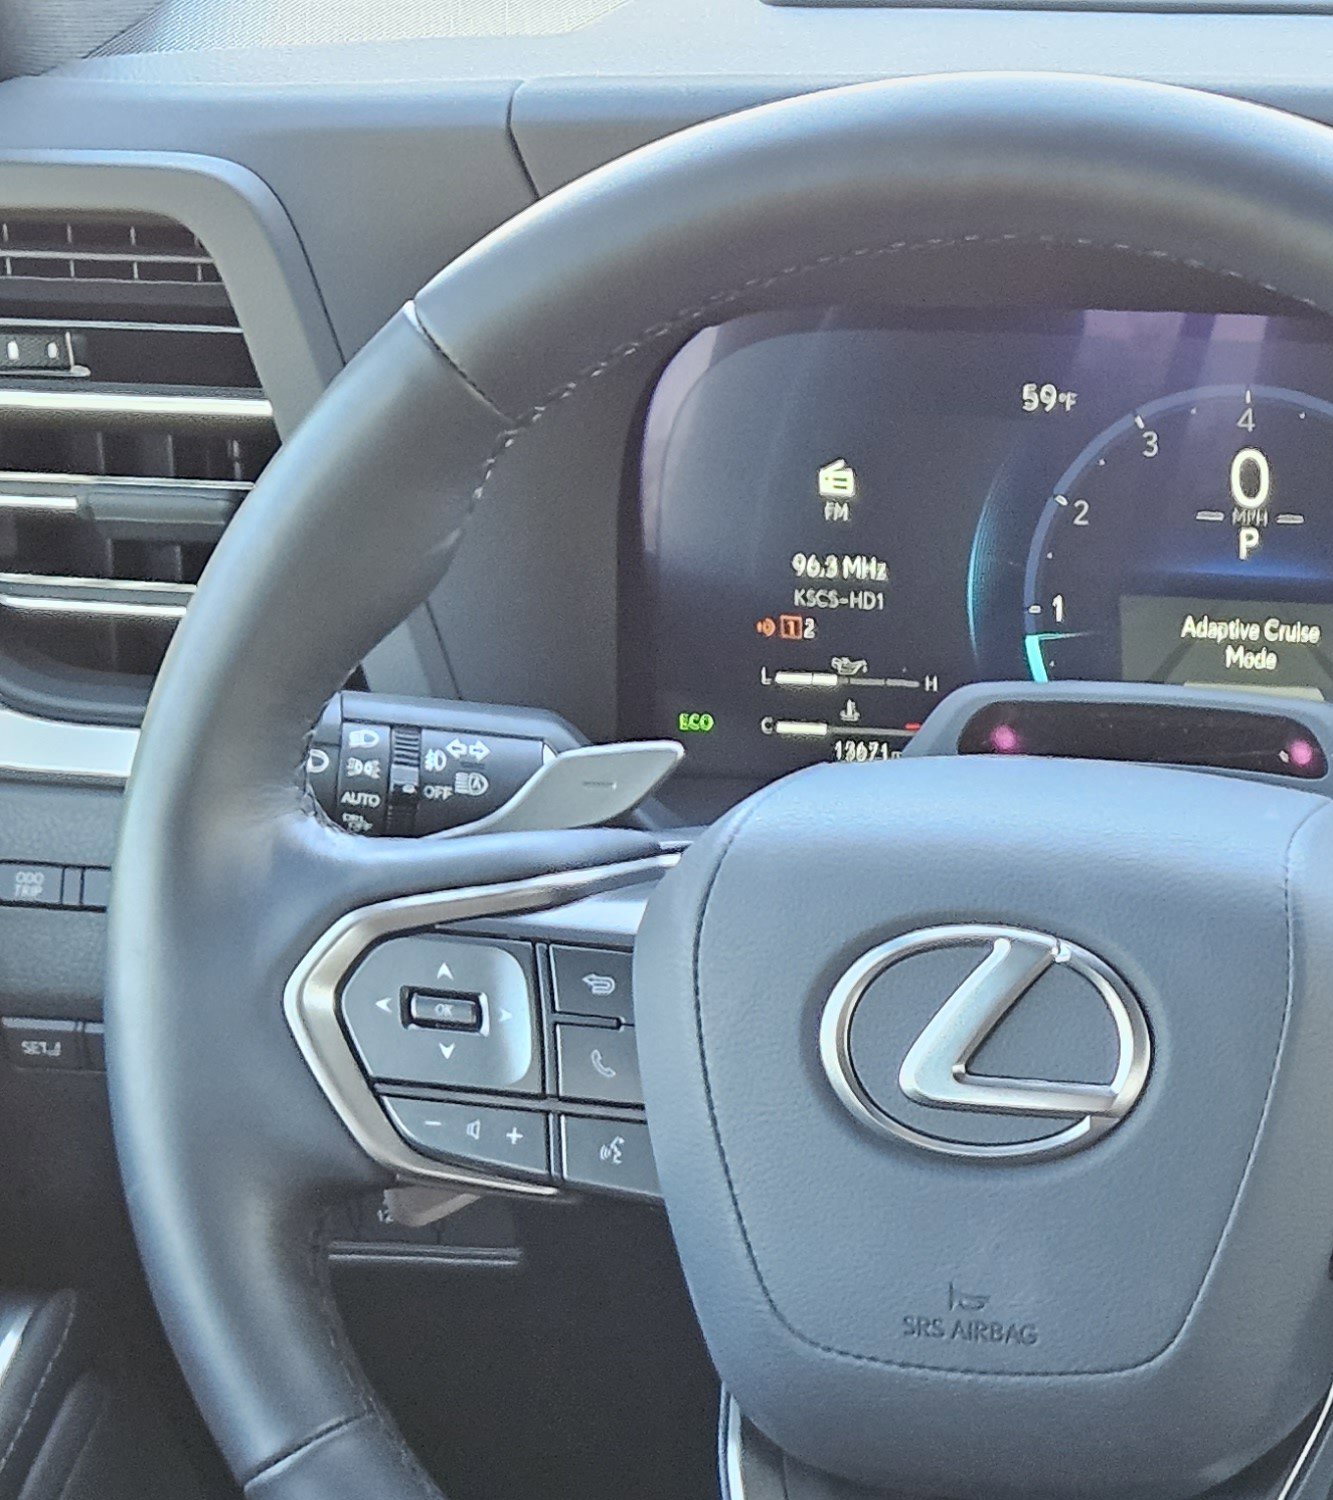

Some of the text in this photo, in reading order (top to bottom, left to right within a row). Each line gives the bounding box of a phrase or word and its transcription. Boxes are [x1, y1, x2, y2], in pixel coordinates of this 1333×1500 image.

[1236, 407, 1256, 432] 4
[1142, 431, 1159, 458] 3
[1230, 447, 1270, 509] 0
[823, 501, 851, 522] FM
[1072, 500, 1089, 526] 2
[1231, 507, 1269, 528] MPH
[1238, 525, 1261, 561] P
[791, 552, 889, 582] 96.3 MHz
[793, 588, 885, 611] KSCS-HD1
[1051, 596, 1064, 622] 1
[803, 617, 816, 639] 2
[1180, 614, 1321, 644] Adaptive Cruise
[1225, 644, 1278, 671] Mode
[678, 712, 715, 732] ECO
[340, 790, 381, 809] AUTO
[423, 785, 453, 800] OFF
[434, 1002, 453, 1017] OK
[902, 1314, 1039, 1346] SRS AIRBAG
